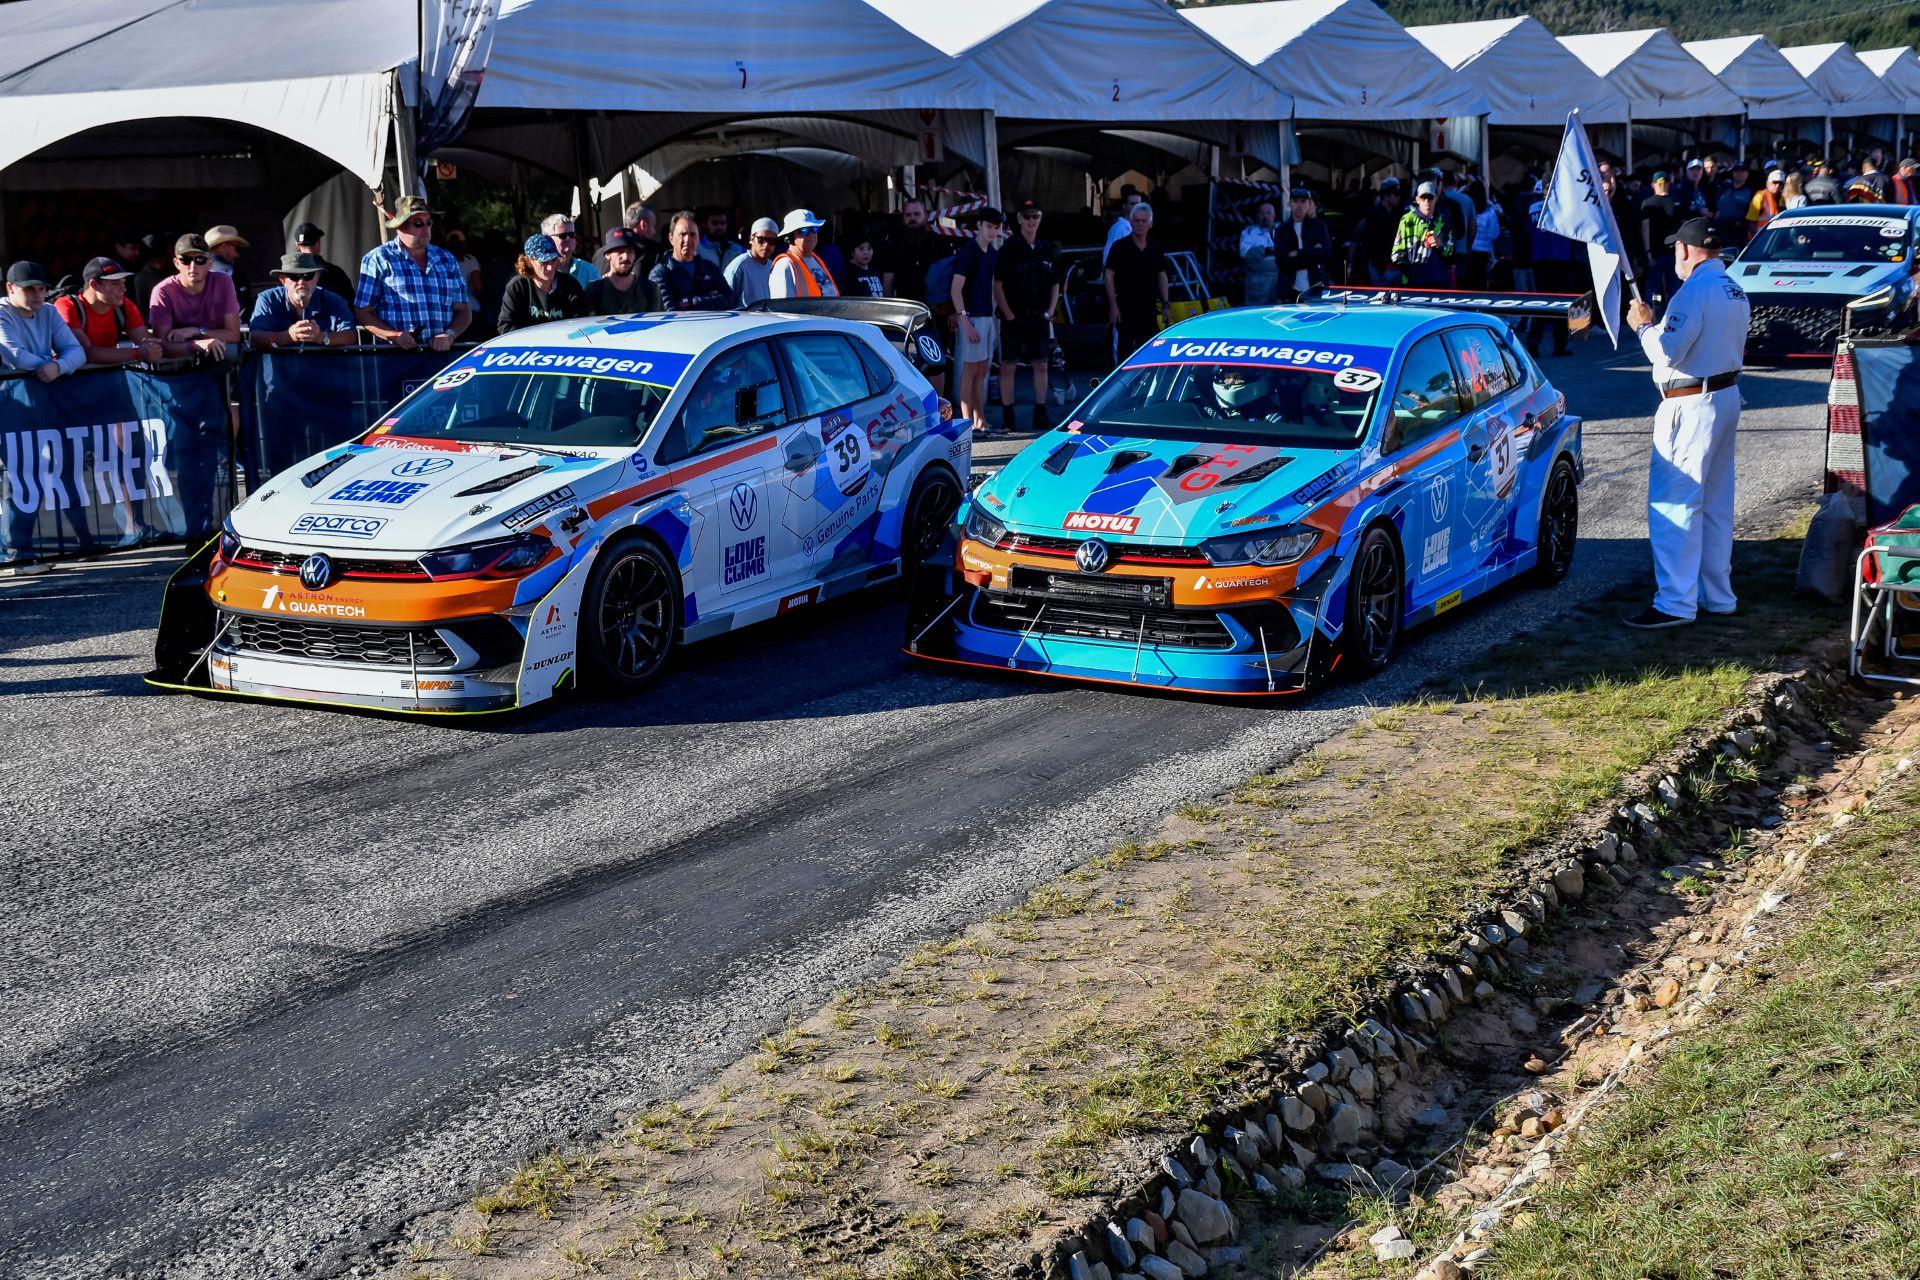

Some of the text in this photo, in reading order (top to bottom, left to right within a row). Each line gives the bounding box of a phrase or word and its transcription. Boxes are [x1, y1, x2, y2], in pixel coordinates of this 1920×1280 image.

[1112, 84, 1120, 102] 2
[482, 350, 654, 375] Volkswagen
[1169, 342, 1355, 367] Volkswagen
[442, 372, 471, 385] 39
[1340, 371, 1378, 387] 37
[833, 433, 861, 473] 39
[1495, 434, 1510, 476] 37
[0, 418, 174, 514] URTHER
[342, 479, 431, 495] LOVE
[327, 489, 413, 504] CLIMB
[816, 484, 880, 543] Genuine Parts
[298, 515, 381, 533] sparco
[1066, 514, 1135, 532] MOTUL
[724, 535, 766, 568] LOVE
[724, 557, 766, 586] CLIMB
[1215, 578, 1269, 589] QUARTECH
[289, 591, 333, 601] ASTRON
[787, 594, 809, 609] MOTUL
[288, 601, 366, 617] QUARTECH
[540, 623, 567, 636] ASTRON
[532, 650, 575, 671] DUNLOP
